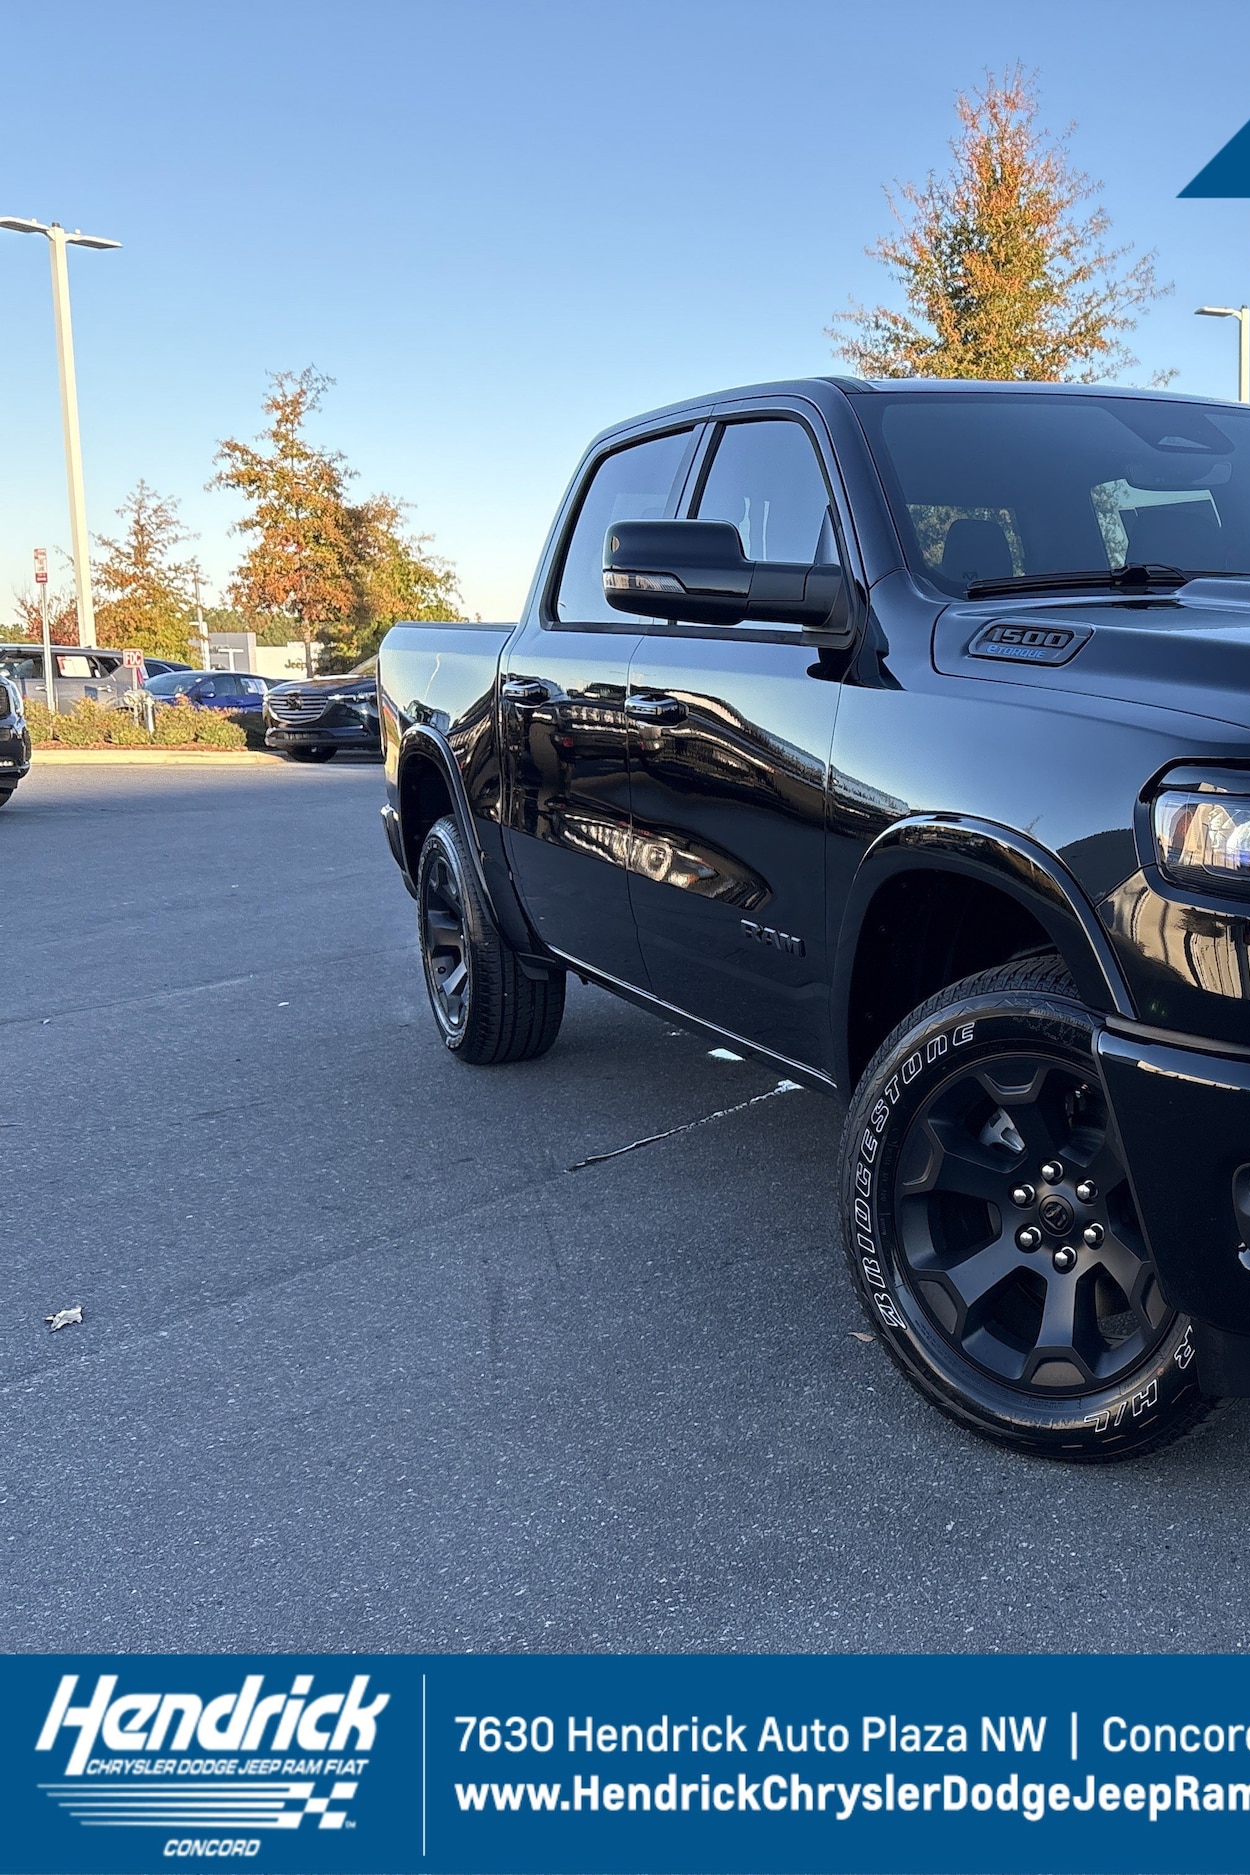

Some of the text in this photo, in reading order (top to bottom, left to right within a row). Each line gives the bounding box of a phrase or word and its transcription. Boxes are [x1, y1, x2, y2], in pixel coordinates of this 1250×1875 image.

[991, 628, 1069, 647] 1500
[125, 651, 142, 665] FDC
[740, 918, 807, 958] RAM
[853, 1021, 977, 1331] BRIDGESTONE
